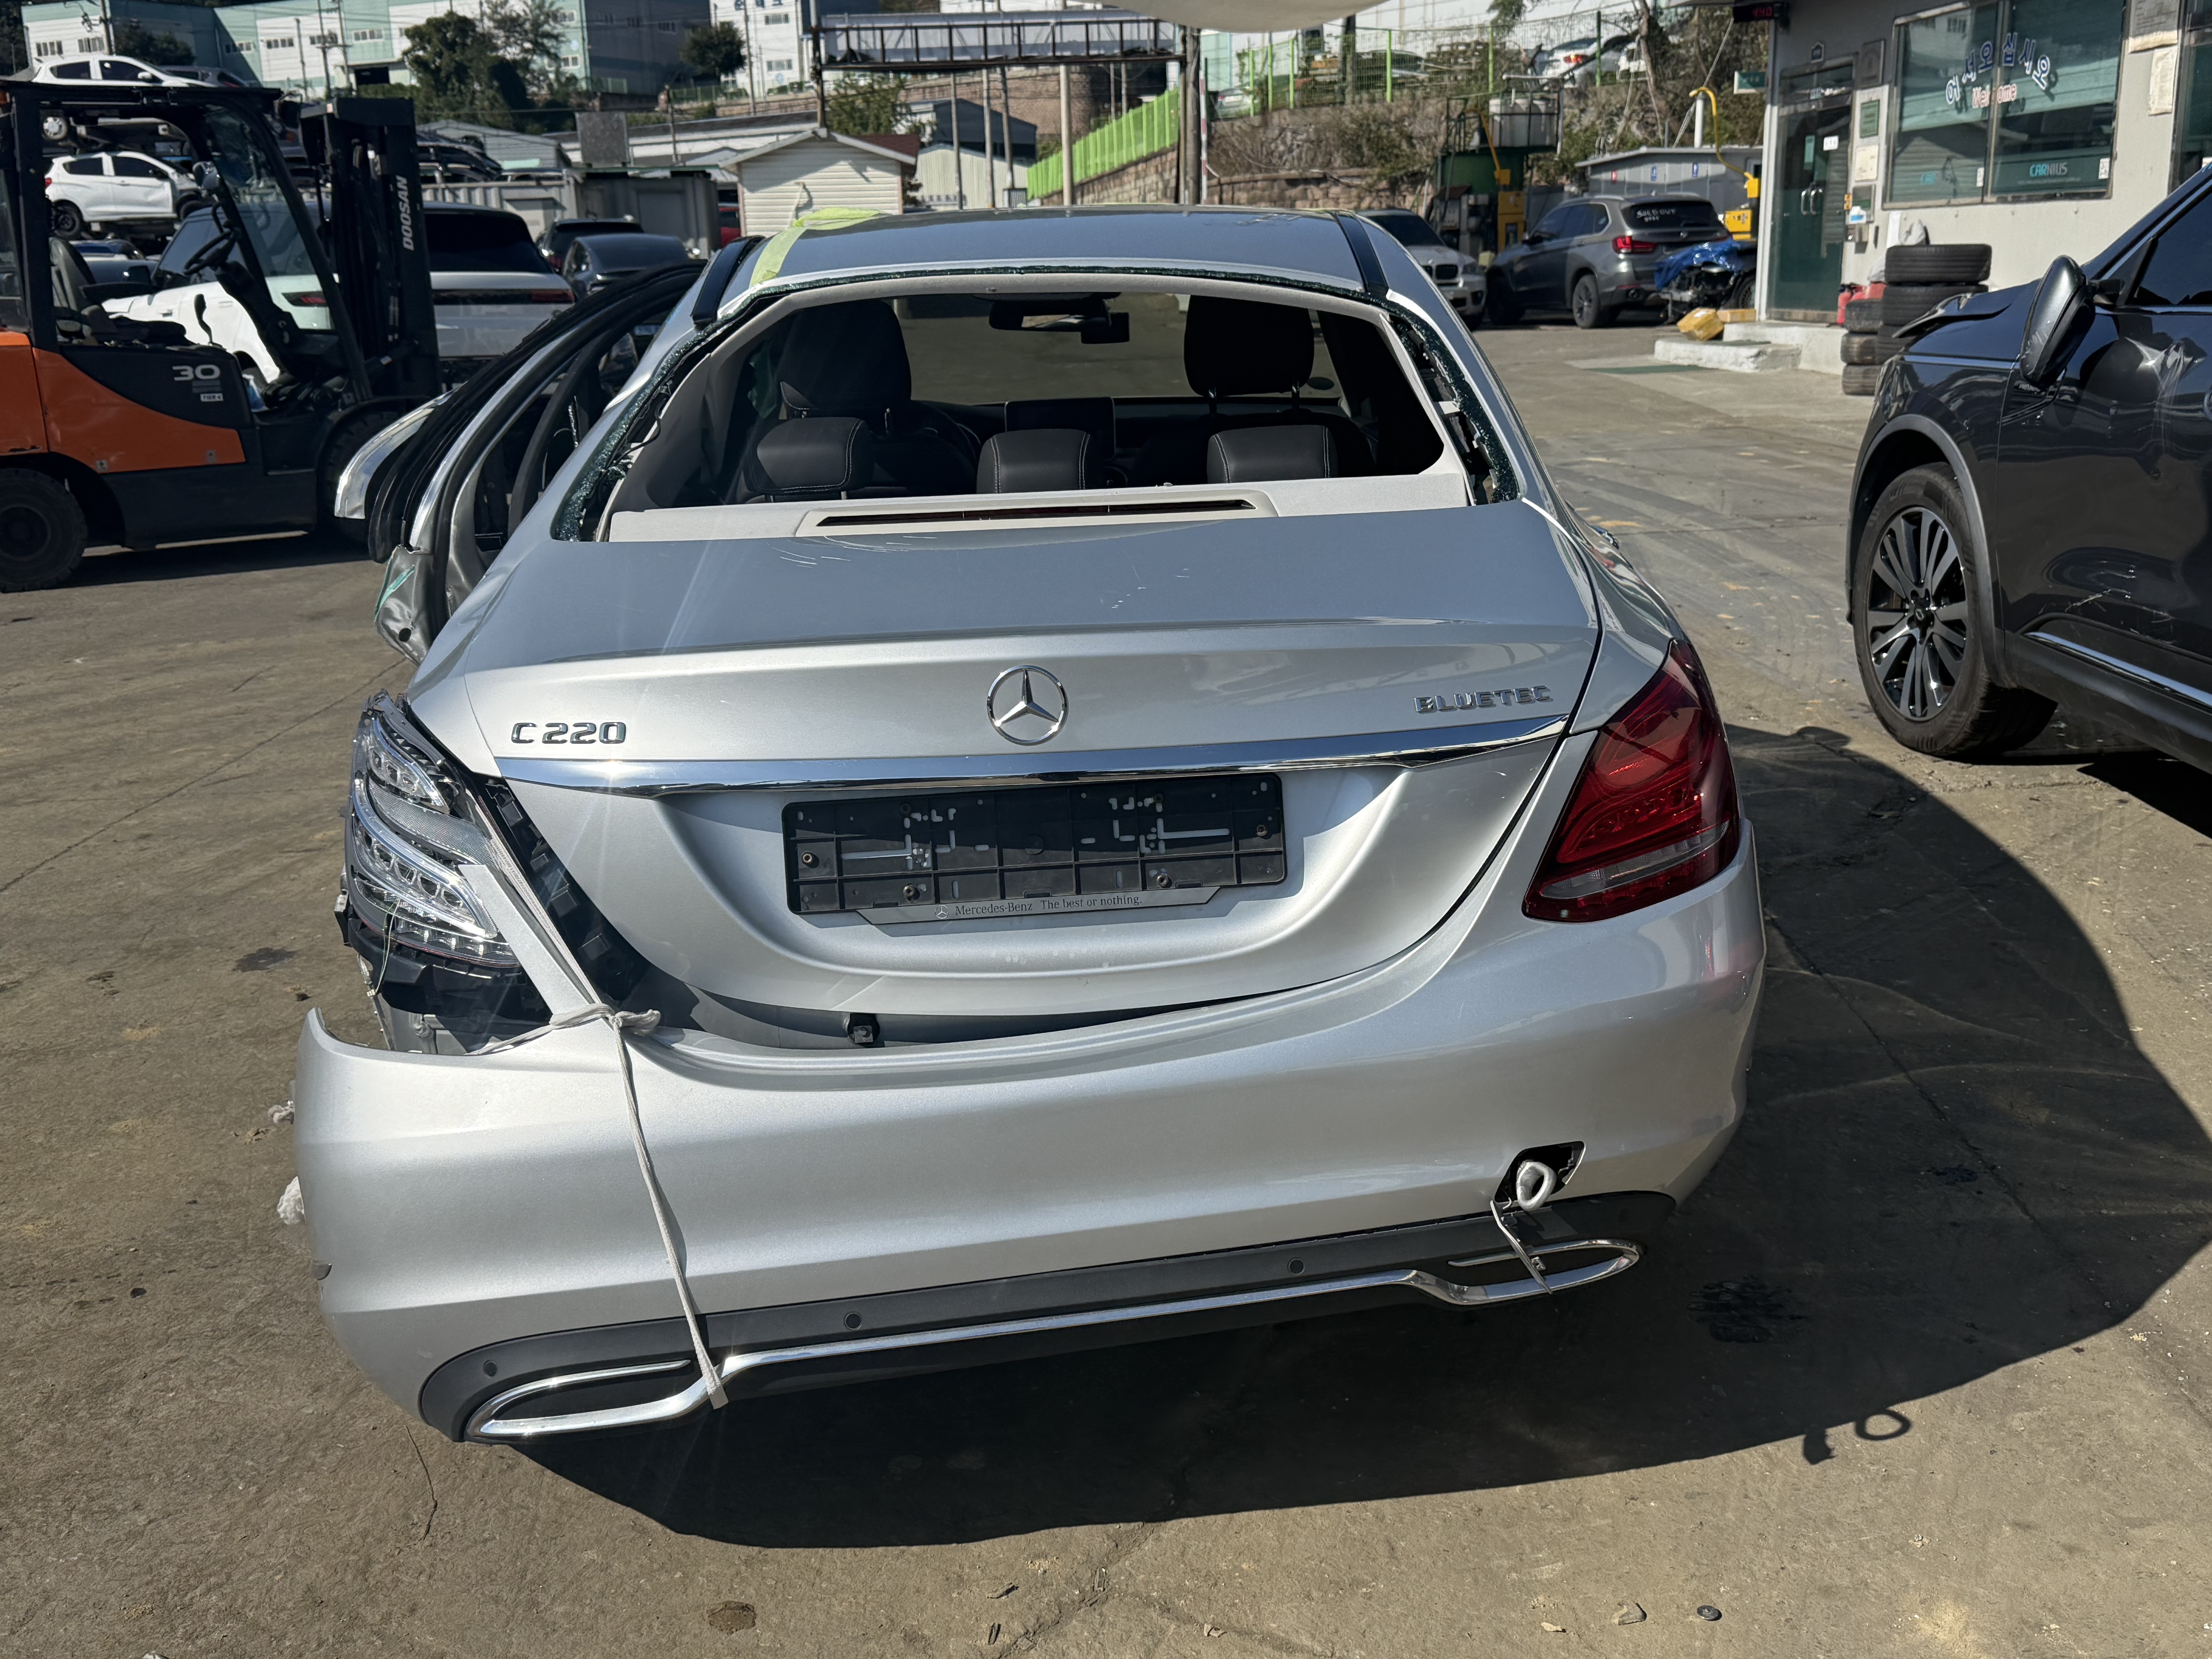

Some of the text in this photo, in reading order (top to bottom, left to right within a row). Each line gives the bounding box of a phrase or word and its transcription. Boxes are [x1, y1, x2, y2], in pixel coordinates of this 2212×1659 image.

[1946, 32, 2050, 105] 어서오십시오
[396, 175, 414, 251] DOOSAN
[172, 364, 220, 381] 30
[1414, 685, 1550, 713] BLUETEC
[511, 722, 626, 744] C 220
[955, 902, 1033, 915] Mercedes-Benz
[1040, 900, 1060, 909] The
[1063, 898, 1084, 908] best
[1100, 896, 1142, 905] nothing.
